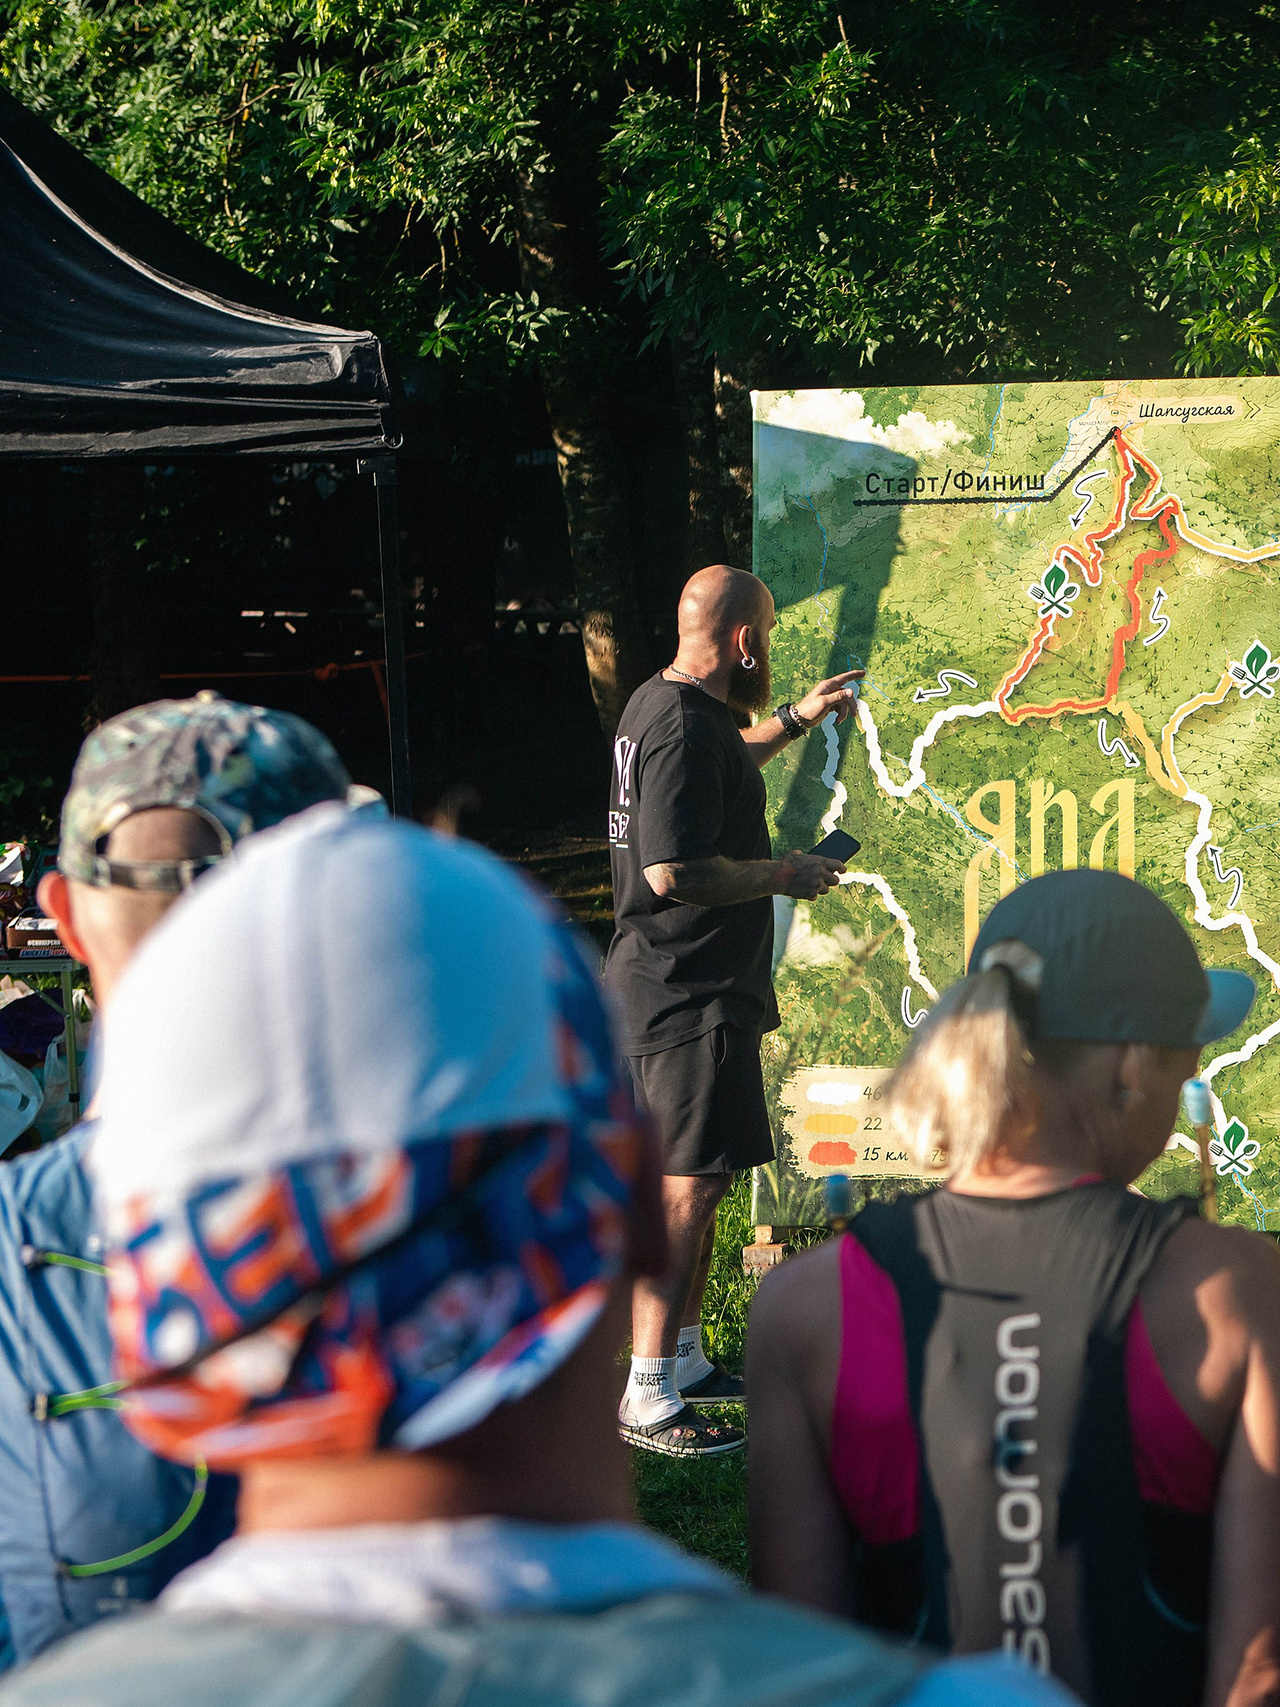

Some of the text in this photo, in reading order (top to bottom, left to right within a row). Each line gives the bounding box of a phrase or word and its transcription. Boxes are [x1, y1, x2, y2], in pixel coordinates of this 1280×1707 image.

[1139, 403, 1235, 423] Шапсугская
[865, 469, 1045, 498] Старт/Финиш
[863, 1085, 883, 1101] 46
[863, 1116, 883, 1131] 22
[862, 1147, 881, 1161] 15
[886, 1150, 909, 1161] км
